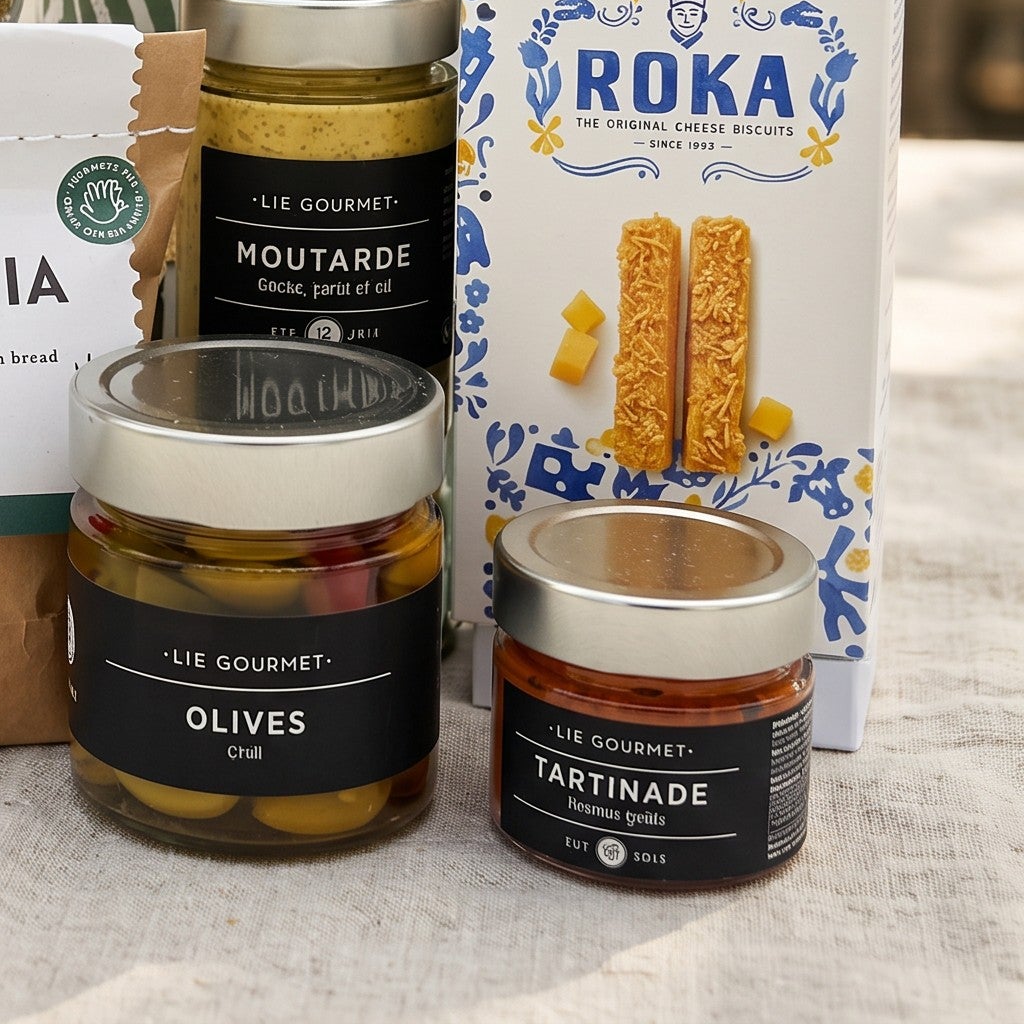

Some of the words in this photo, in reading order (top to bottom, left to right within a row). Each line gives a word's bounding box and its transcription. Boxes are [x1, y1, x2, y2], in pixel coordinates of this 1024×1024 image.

[576, 49, 795, 118] ROKA
[576, 117, 600, 130] THE
[606, 118, 668, 132] ORIGINAL
[675, 121, 726, 135] CHEESE
[732, 123, 794, 136] BISCUITS
[649, 139, 683, 150] SINCE
[687, 140, 715, 151] 1993
[237, 240, 411, 272] MOUTARDE
[316, 326, 331, 340] 12
[11, 349, 59, 365] bread
[185, 705, 306, 736] OLIVES
[534, 754, 708, 806] TARTINADE
[565, 836, 590, 852] EUT
